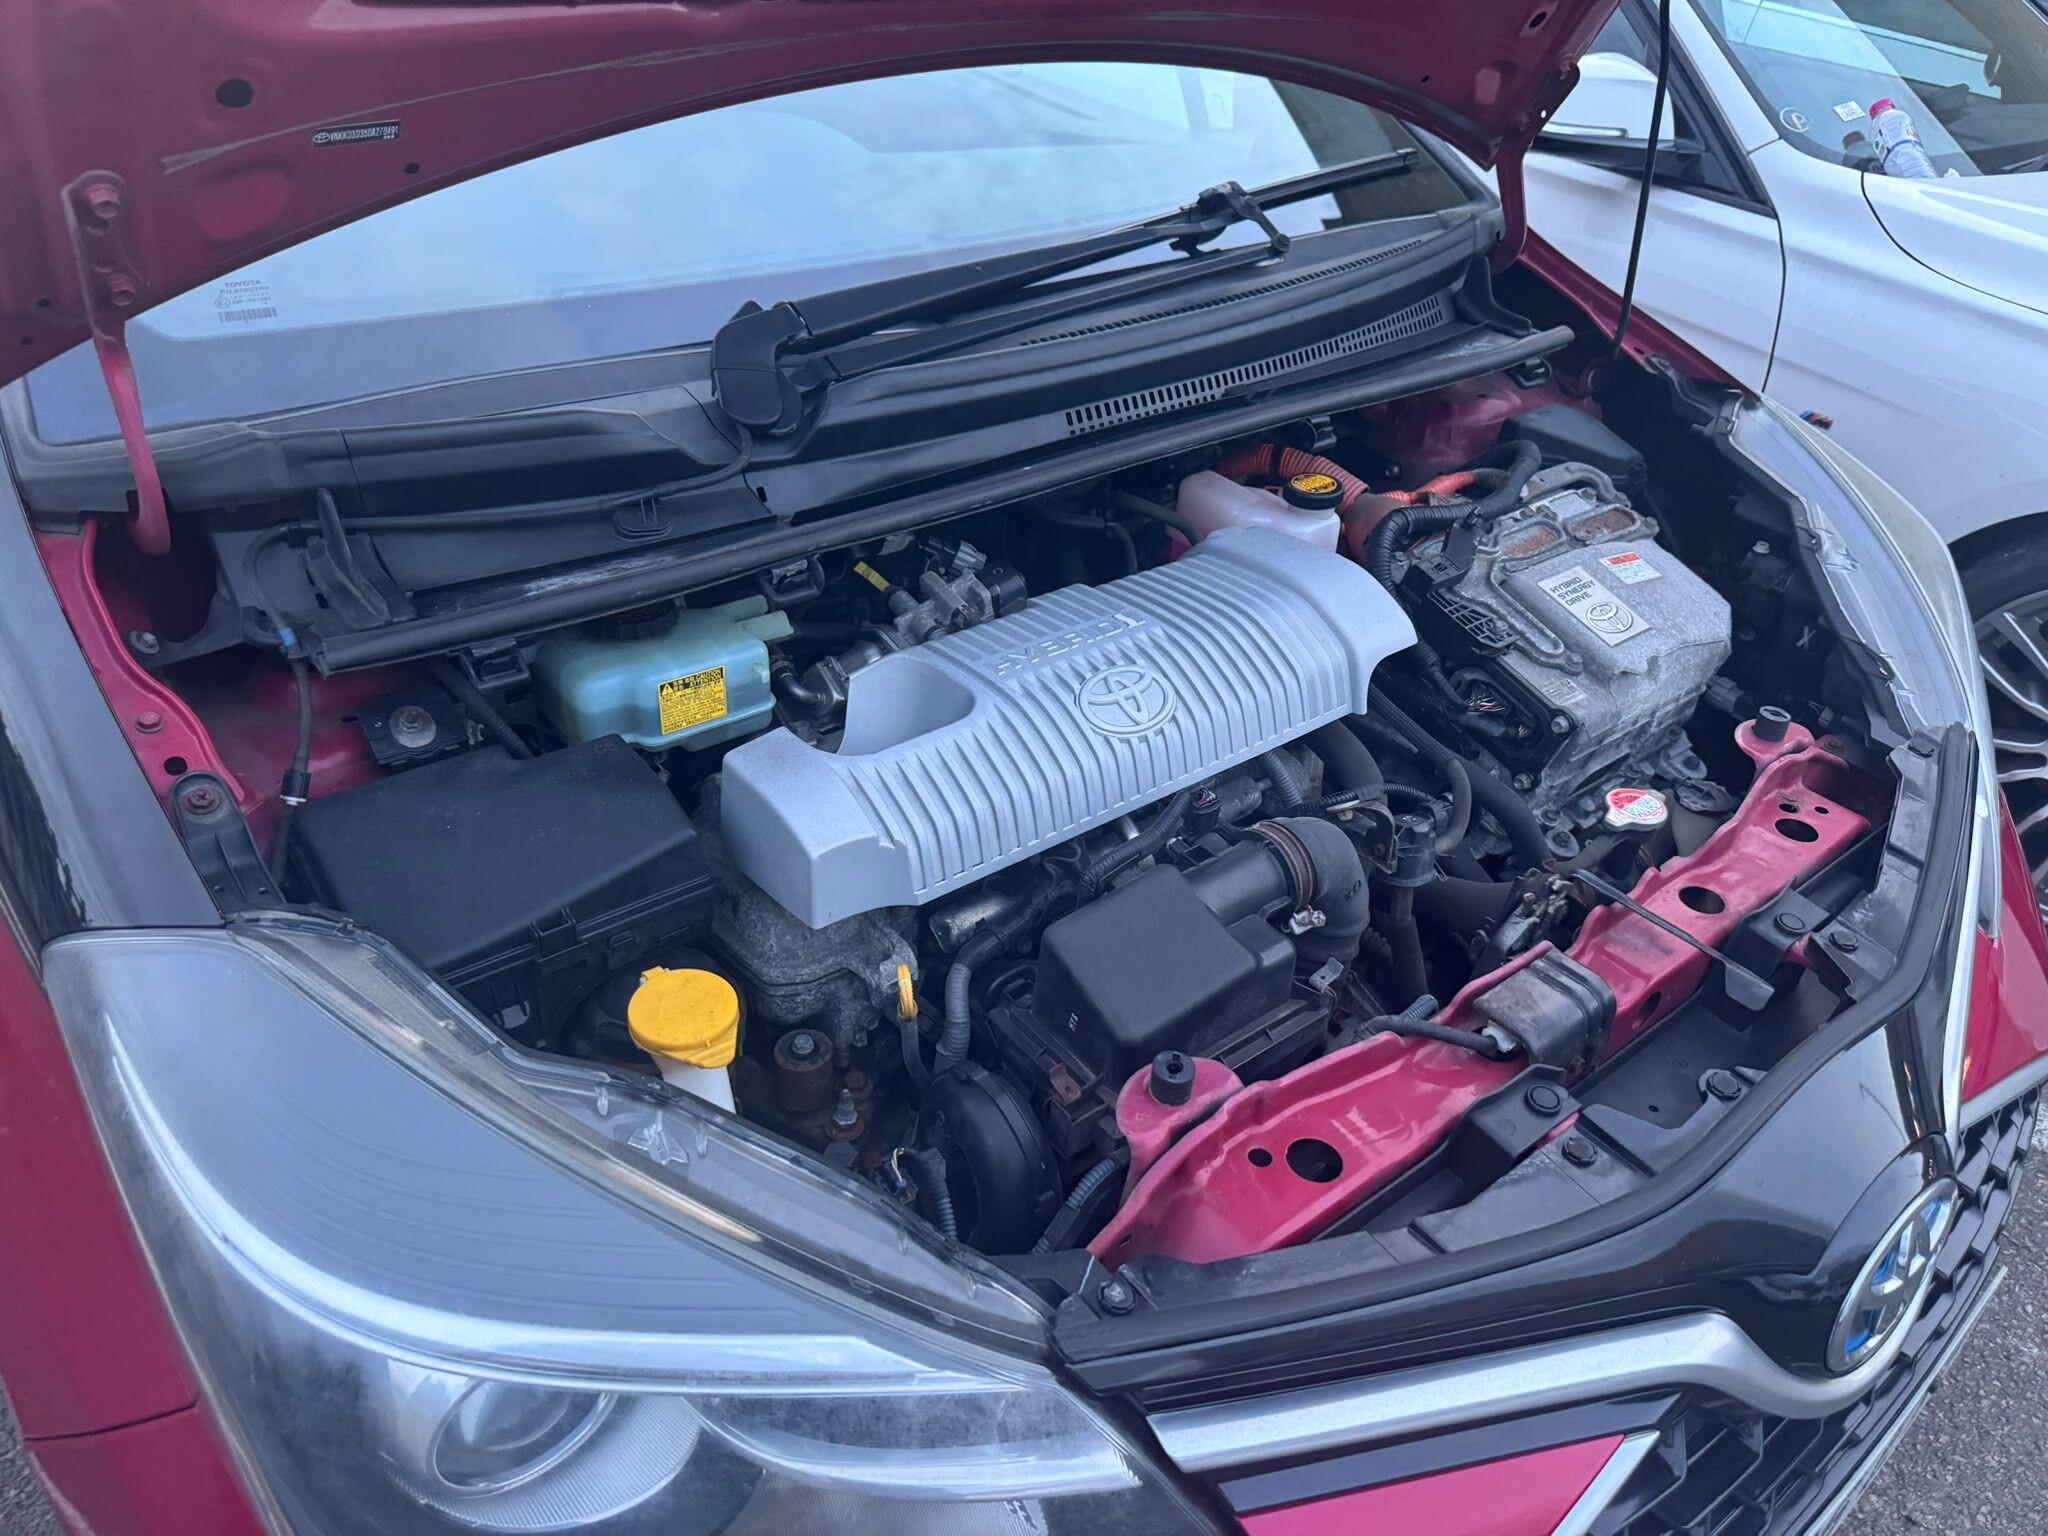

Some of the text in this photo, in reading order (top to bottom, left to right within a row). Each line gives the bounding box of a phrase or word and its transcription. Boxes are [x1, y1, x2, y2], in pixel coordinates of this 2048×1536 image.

[225, 280, 262, 288] TOYOTA
[1550, 576, 1583, 594] HYBRID
[1557, 579, 1595, 600] SYNERGY
[1565, 590, 1593, 606] DRIVE
